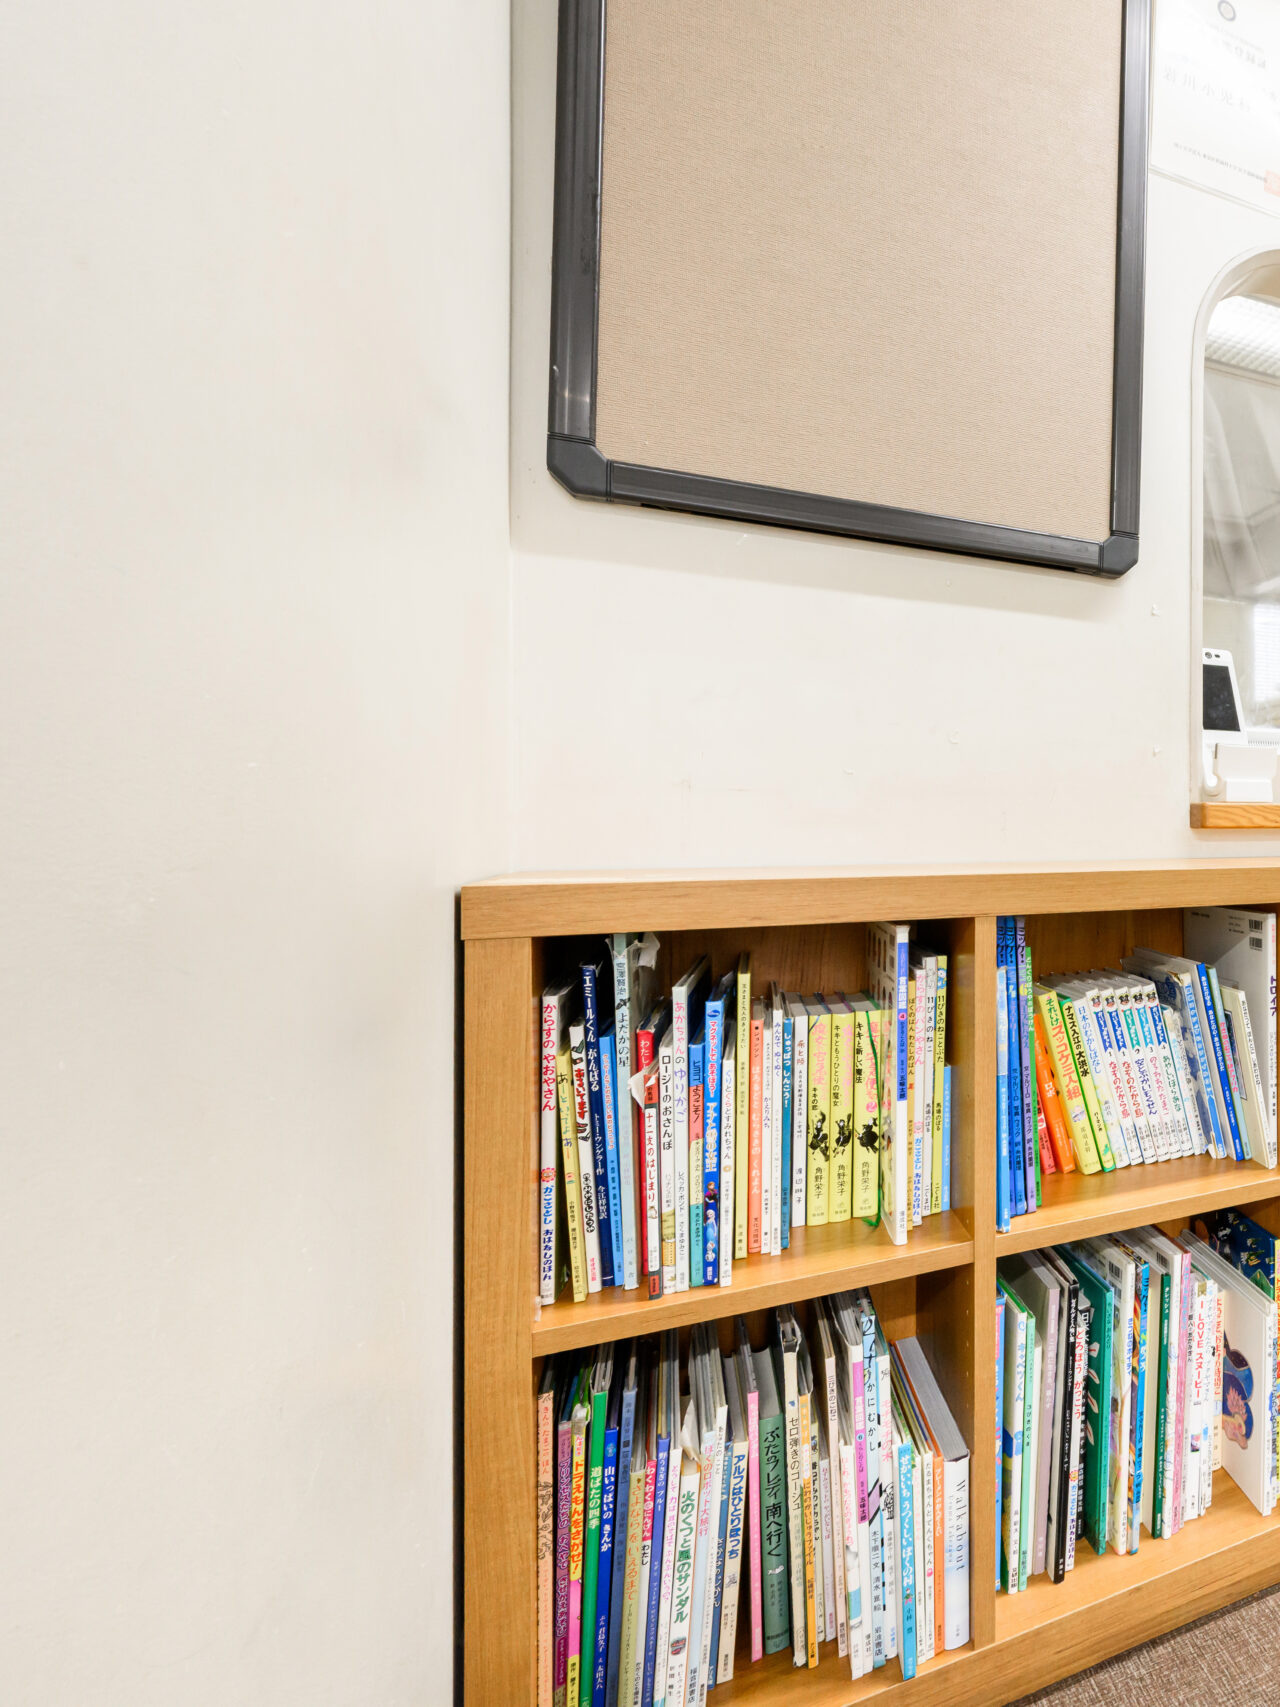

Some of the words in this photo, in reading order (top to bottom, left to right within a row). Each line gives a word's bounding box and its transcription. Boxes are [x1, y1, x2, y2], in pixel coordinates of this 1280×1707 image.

[1006, 926, 1015, 963] ミッケ!
[1017, 926, 1026, 963] ミッケ!
[543, 1004, 557, 1049] からすの
[583, 975, 596, 1042] エミールくん
[936, 995, 945, 1063] 11ぴきのねことぶた
[617, 1013, 630, 1067] よだかの星
[674, 1001, 687, 1123] あかちゃんのゆりかご
[832, 1025, 841, 1106] キキともうひとりの魔女
[855, 1022, 863, 1083] キキと新しい魔法
[914, 1017, 925, 1065] パンやさん
[1078, 1006, 1100, 1074] 日本のむかしばなし
[542, 1053, 556, 1112] やおやさん
[588, 1049, 600, 1092] がんばる
[662, 1055, 674, 1151] ロージーのおさんぽ
[646, 1113, 657, 1202] 十二支のはじまり
[543, 1184, 554, 1225] かこさとし
[542, 1228, 553, 1281] おはなしのほん
[1196, 1313, 1205, 1349] LOVE
[828, 1375, 837, 1422] 三びきのこねこ
[1015, 1343, 1027, 1402] キャベツくん
[1194, 1352, 1204, 1399] スヌーピー
[881, 1399, 893, 1463] モチモチの木
[602, 1466, 616, 1519] 山いっぱいの
[645, 1466, 656, 1500] わくわく
[657, 1452, 667, 1487] 野うさぎの
[699, 1444, 713, 1537] ぼくのロボット大旅行
[764, 1426, 784, 1557] ぶたのフレディ南へ行く
[789, 1417, 802, 1511] セロ弾きのゴーシュ
[900, 1456, 911, 1498] せかいいち
[558, 1459, 571, 1530] プリンセスたちの
[571, 1459, 584, 1575] ドラえもんをさがせ!
[588, 1466, 602, 1529] 道ばたの四季
[656, 1490, 665, 1511] フルー
[728, 1454, 746, 1560] アルフはひとりぼっち
[867, 1382, 877, 1452] かにむかし
[874, 1625, 883, 1657] 岩波書店
[901, 1501, 912, 1545] うつくしい
[601, 1524, 612, 1552] きんか
[627, 1485, 642, 1601] さよならをいえるまで
[955, 1479, 968, 1571] Walkabout
[641, 1544, 650, 1566] わたし
[674, 1491, 695, 1623] 火のくつと風のサンダル
[902, 1546, 914, 1586] ぼくの村
